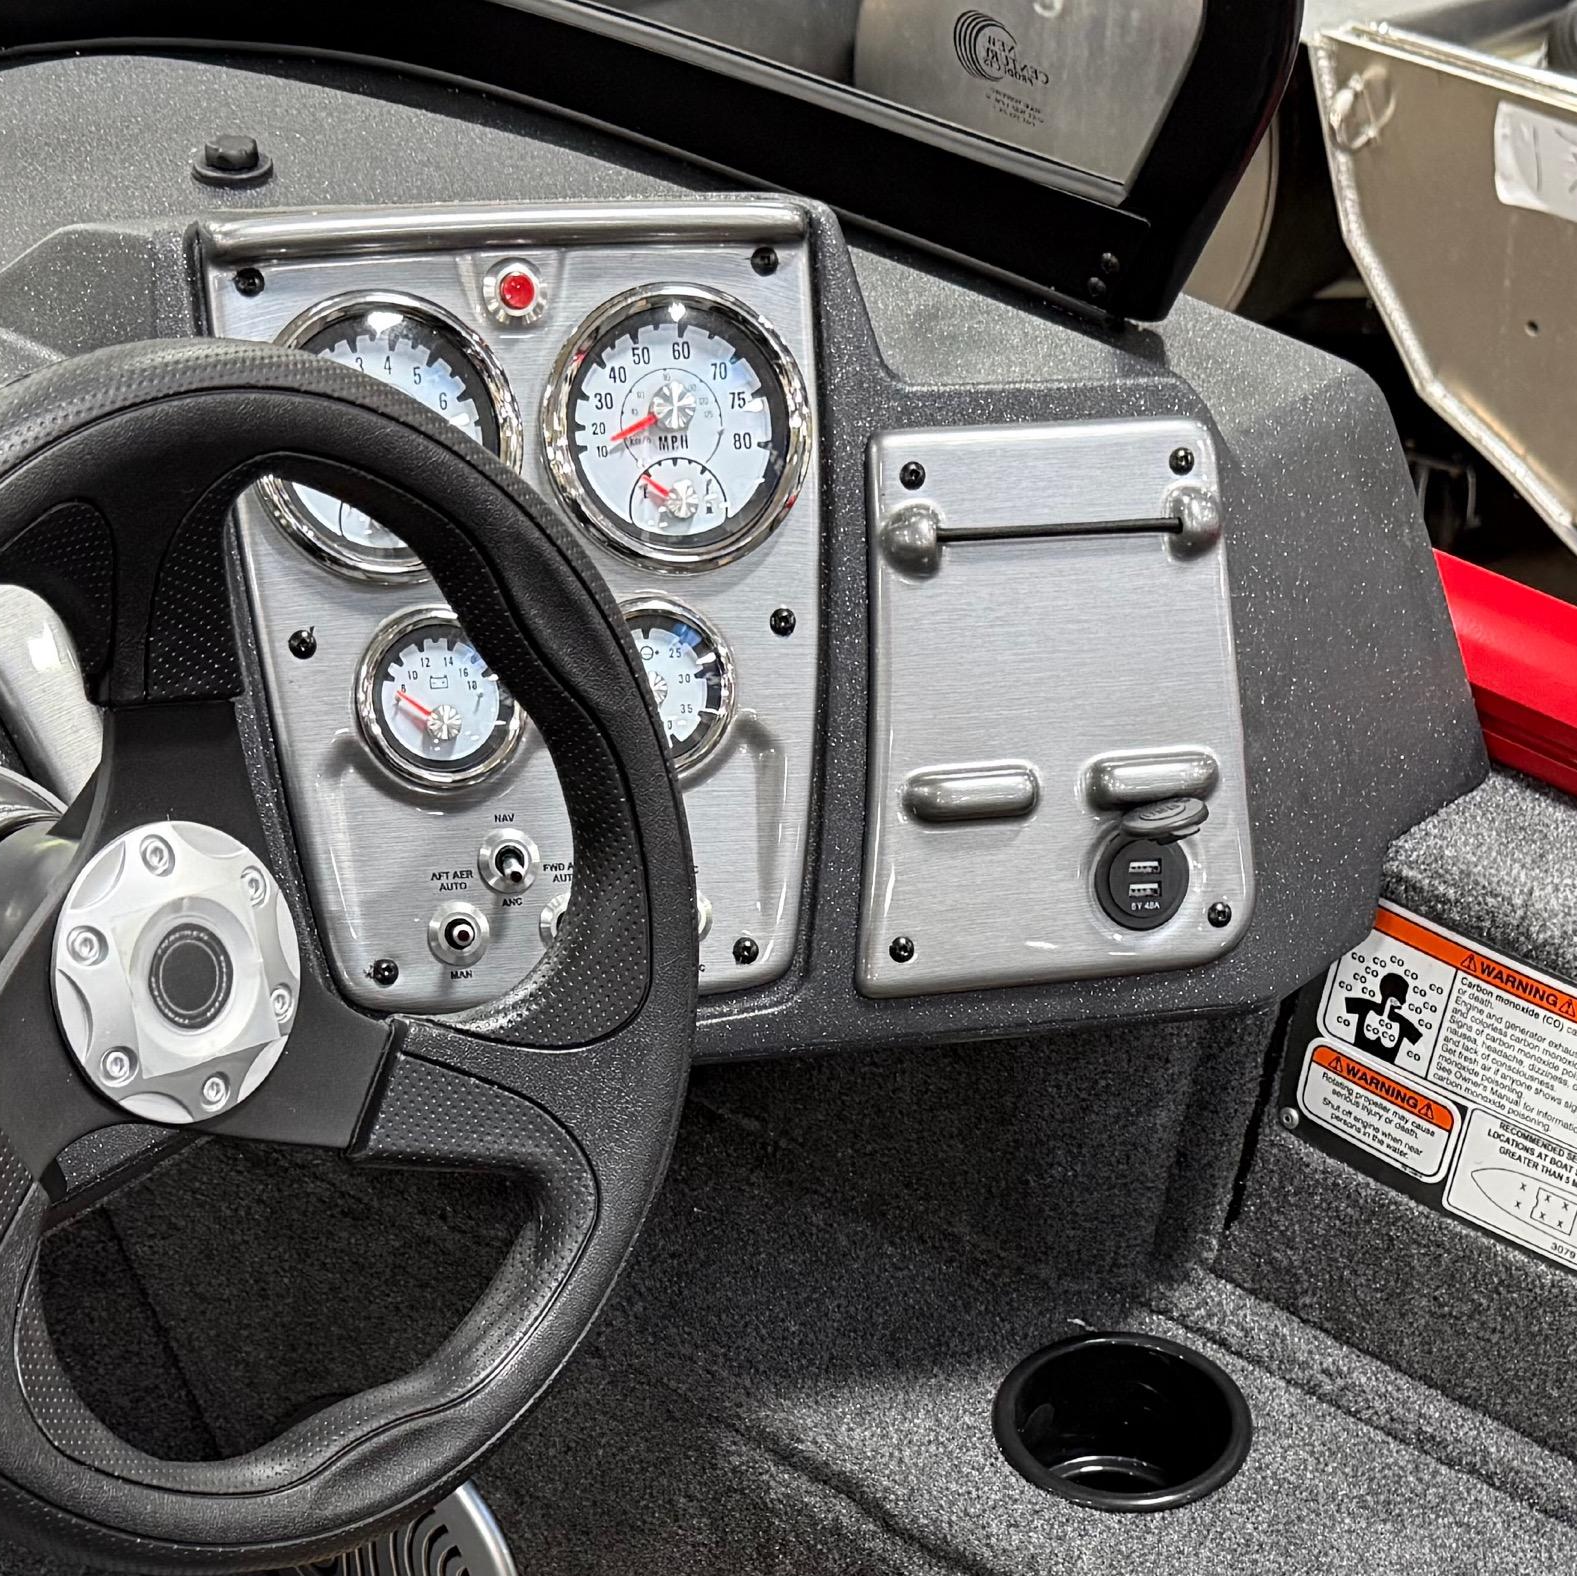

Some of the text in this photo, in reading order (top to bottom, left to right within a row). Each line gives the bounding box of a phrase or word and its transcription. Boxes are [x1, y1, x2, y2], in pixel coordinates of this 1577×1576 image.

[632, 346, 650, 365] 50
[672, 341, 690, 360] 60
[384, 356, 392, 375] 4
[711, 362, 728, 380] 70
[413, 366, 422, 385] 5
[608, 366, 627, 384] 40
[439, 392, 448, 411] 6
[594, 392, 614, 410] 30
[729, 392, 747, 409] 75
[592, 422, 606, 436] 20
[658, 435, 689, 451] MPH
[733, 432, 752, 450] 80
[596, 446, 608, 458] 10
[444, 656, 454, 667] 14
[669, 648, 682, 658] 25
[420, 657, 430, 668] 12
[407, 670, 418, 680] 10
[459, 667, 469, 678] 16
[678, 673, 691, 684] 30
[680, 703, 693, 714] 35
[494, 813, 515, 823] NAV
[431, 870, 473, 882] AFT AER
[543, 863, 564, 873] FWD
[439, 881, 467, 891] AUTO
[1351, 952, 1365, 963] CO
[1390, 955, 1404, 967] CO
[450, 970, 473, 980] MAN
[1404, 969, 1418, 980] CO
[1339, 981, 1353, 992] CO
[1429, 984, 1444, 995] CO
[1480, 961, 1559, 1008] WARNING
[1457, 987, 1495, 1009] or death.
[1459, 976, 1494, 999] Carbon
[1494, 992, 1540, 1019] monoxide
[1541, 1013, 1565, 1031] (CO)
[1337, 1016, 1350, 1027] CO
[1451, 1006, 1468, 1019] and
[1469, 1014, 1508, 1037] colorless
[1508, 1032, 1541, 1052] carbon
[1453, 996, 1484, 1017] Engine
[1485, 1011, 1503, 1024] and
[1503, 1019, 1546, 1046] generator
[1448, 1015, 1473, 1033] Signs
[1485, 1032, 1515, 1052] carbon
[1516, 1046, 1560, 1072] monoxide
[1407, 1051, 1421, 1061] CO
[1344, 1063, 1419, 1110] WARNING
[1321, 1071, 1435, 1137] Rotating propeller may cause
[1331, 1088, 1419, 1139] serious injury or death.
[1322, 1096, 1422, 1156] Shut off engine when near
[1329, 1112, 1408, 1159] persons in the water.
[1498, 1121, 1565, 1158] RECOMMENDED
[1487, 1128, 1535, 1156] LOCATIONS
[1536, 1150, 1547, 1161] AT
[1548, 1156, 1573, 1173] BOAT
[1498, 1145, 1539, 1170] GREATER
[1540, 1164, 1563, 1181] THAN
